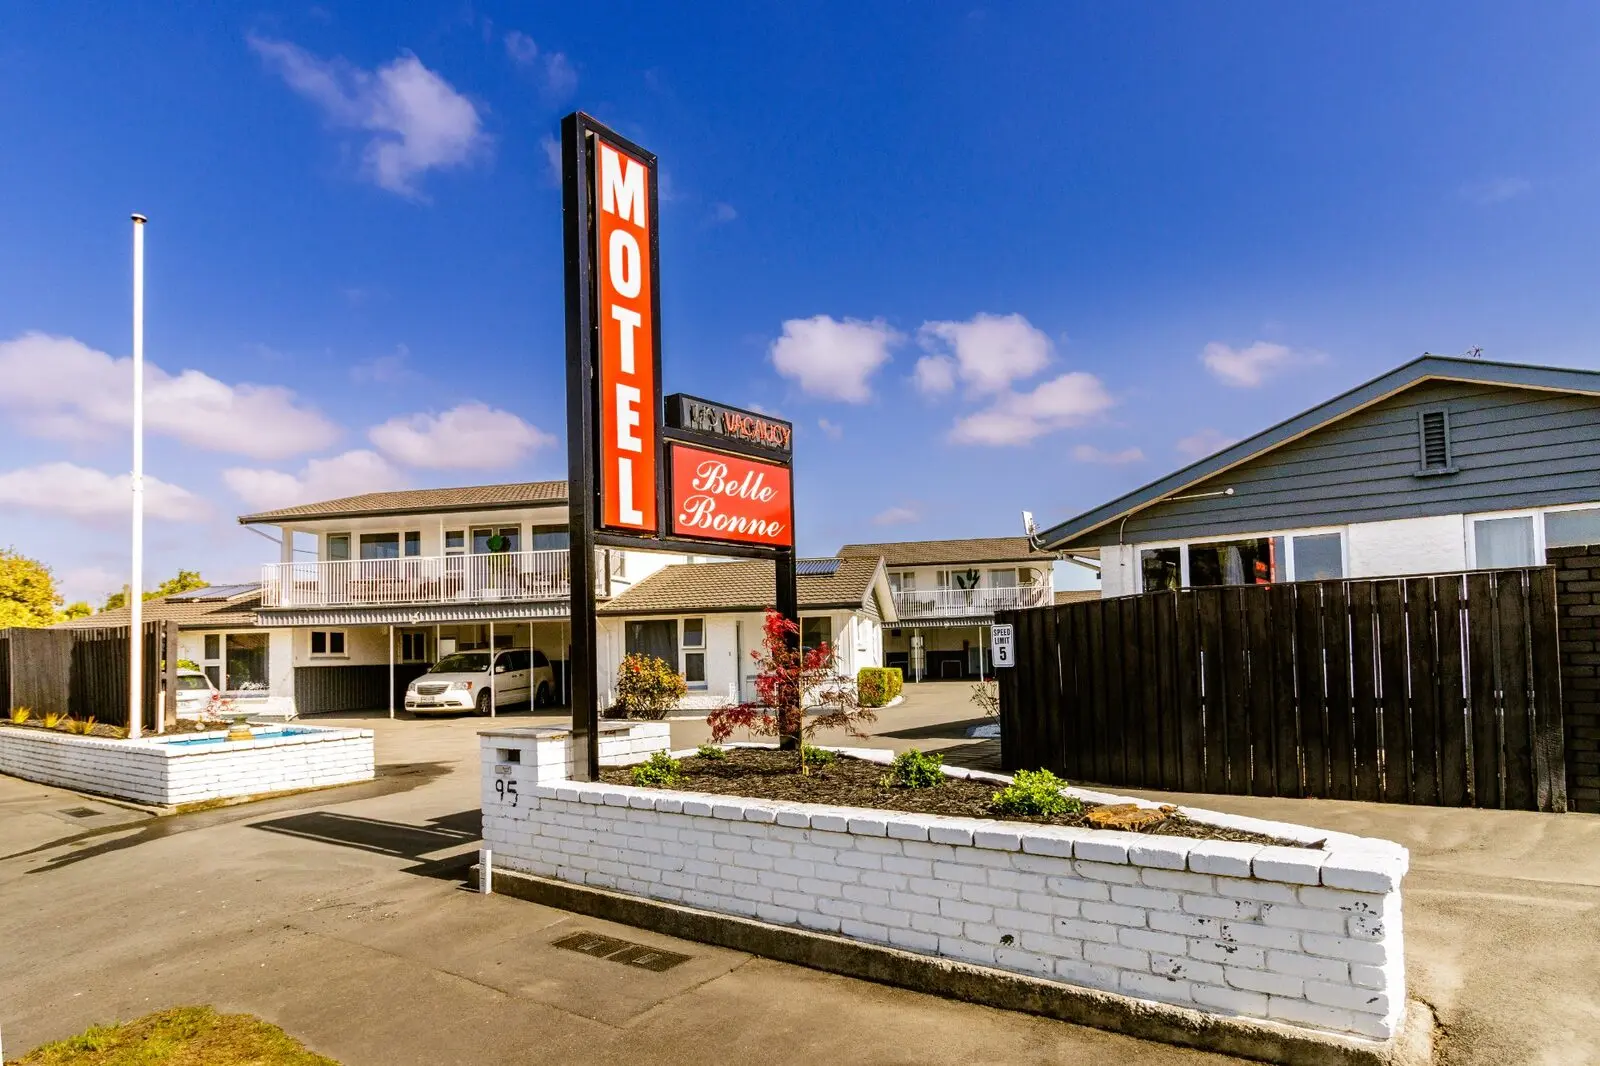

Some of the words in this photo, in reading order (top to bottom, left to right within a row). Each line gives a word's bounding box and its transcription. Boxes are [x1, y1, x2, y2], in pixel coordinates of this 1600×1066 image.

[601, 144, 645, 526] MOTEL
[724, 411, 791, 446] VACANCY
[692, 460, 778, 502] Belle
[679, 494, 785, 537] Bonne
[993, 628, 1010, 636] SPEED
[994, 636, 1010, 645] LIMIT
[999, 646, 1007, 660] 5
[495, 779, 519, 807] 95
